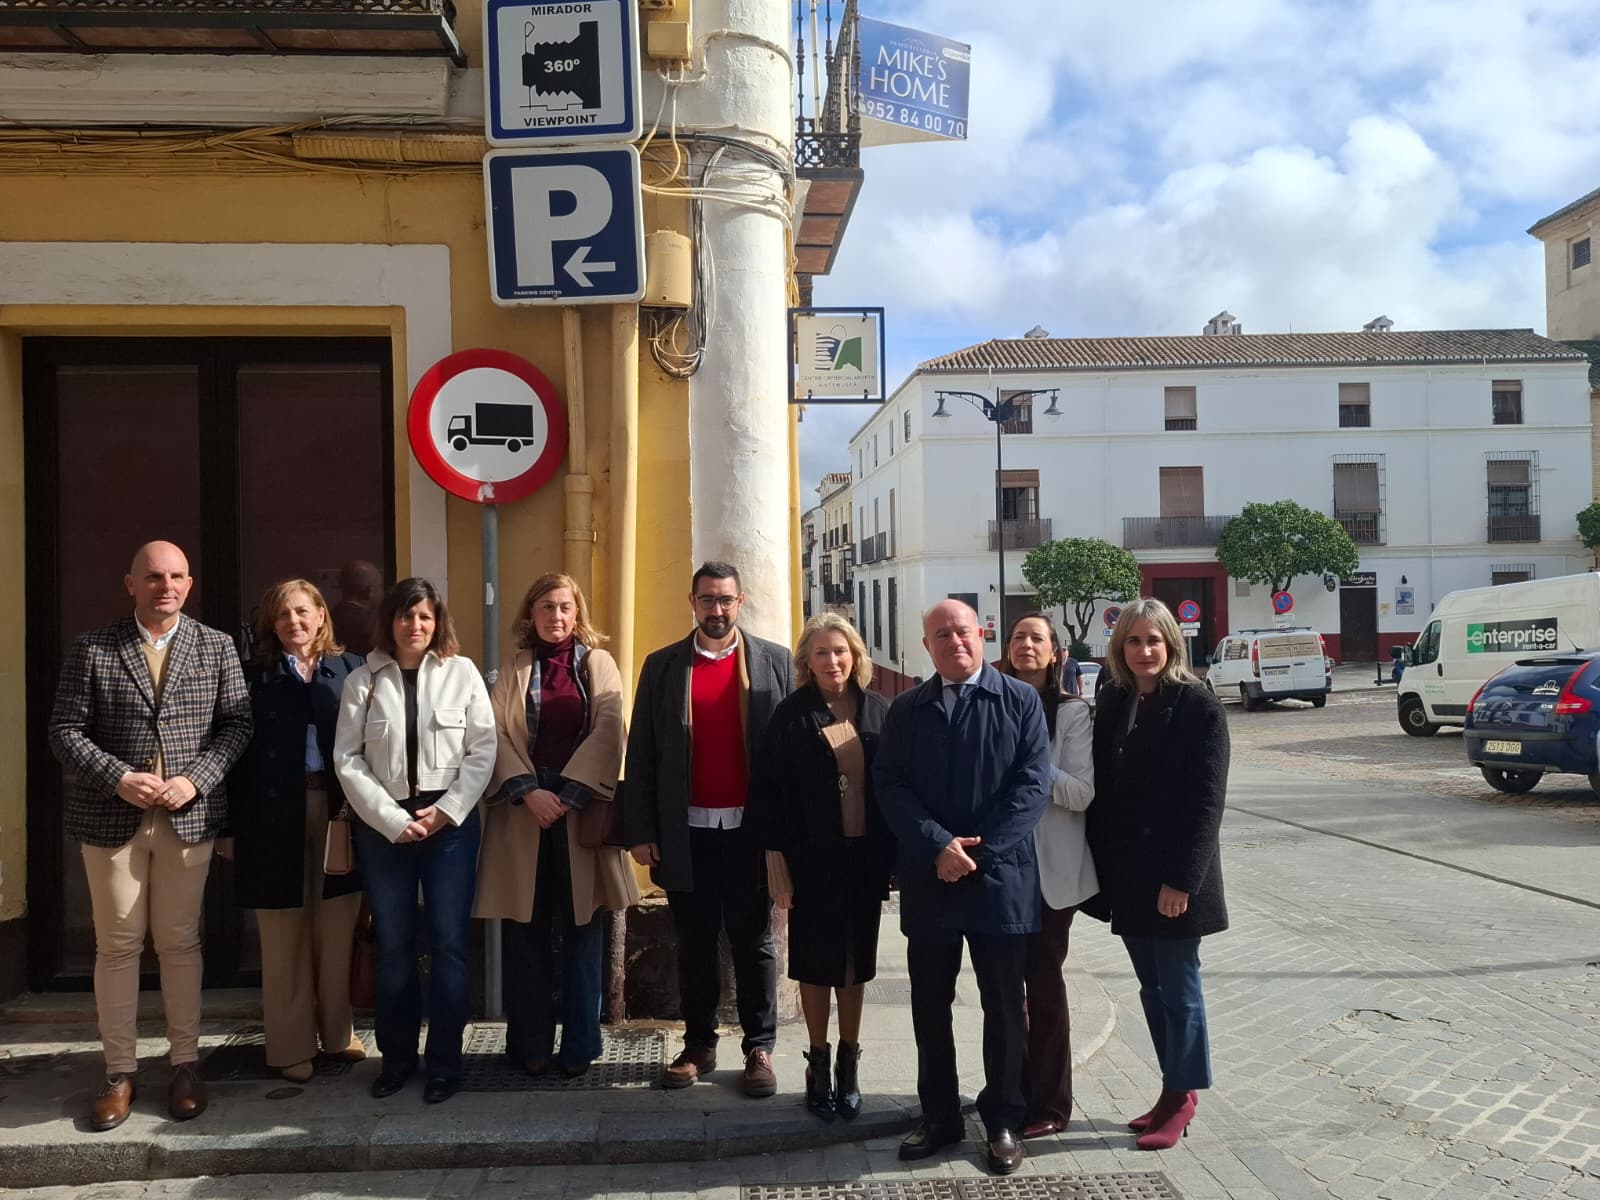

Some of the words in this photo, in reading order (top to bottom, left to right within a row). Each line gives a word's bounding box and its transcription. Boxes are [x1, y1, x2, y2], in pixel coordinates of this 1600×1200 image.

[531, 4, 592, 16] MIRADOR
[877, 45, 947, 81] MIKE'S
[870, 66, 950, 109] HOME
[523, 113, 598, 127] VIEWPOINT
[867, 100, 895, 120] 952
[900, 108, 919, 126] 84
[924, 114, 942, 132] 00
[947, 119, 965, 138] 70
[510, 165, 613, 287] P
[1471, 625, 1556, 648] enterprise
[1522, 641, 1556, 650] rent-a-car
